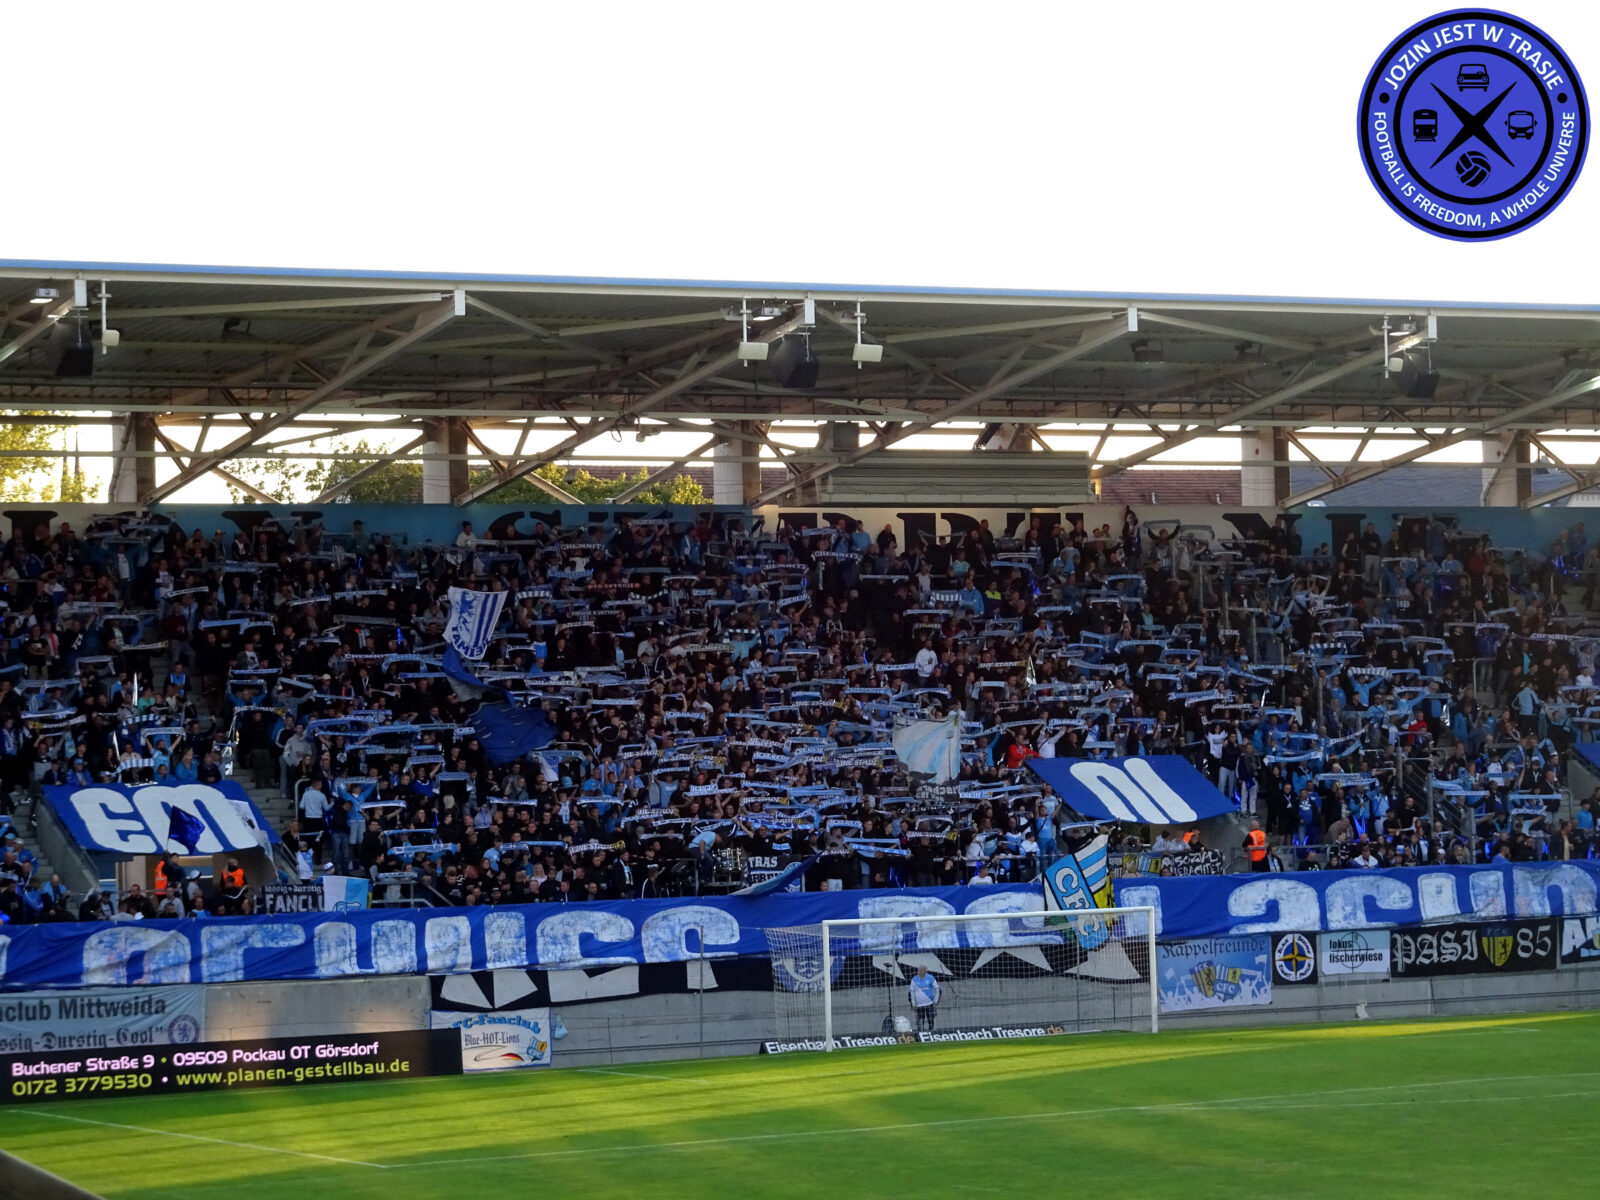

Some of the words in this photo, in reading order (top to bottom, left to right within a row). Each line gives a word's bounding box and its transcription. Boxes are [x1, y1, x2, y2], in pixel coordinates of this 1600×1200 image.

[1329, 939, 1353, 949] fokus
[1516, 924, 1552, 958] 85
[1329, 951, 1383, 963] fischerwiese
[1216, 983, 1236, 993] CFC
[58, 996, 167, 1020] Mittweida
[919, 1028, 993, 1043] Eisenbach
[765, 1037, 842, 1054] Eisenbah
[11, 1060, 81, 1077] Buchener
[85, 1055, 139, 1072] Straße
[142, 1054, 155, 1068] 9
[172, 1050, 229, 1067] 09509
[232, 1047, 286, 1064] Pockau
[289, 1045, 311, 1059] OT
[315, 1041, 380, 1057] Görsdorf
[11, 1078, 58, 1096] 0172
[64, 1073, 153, 1093] 3779530
[175, 1059, 410, 1086] www.planen-gestellbau.de
